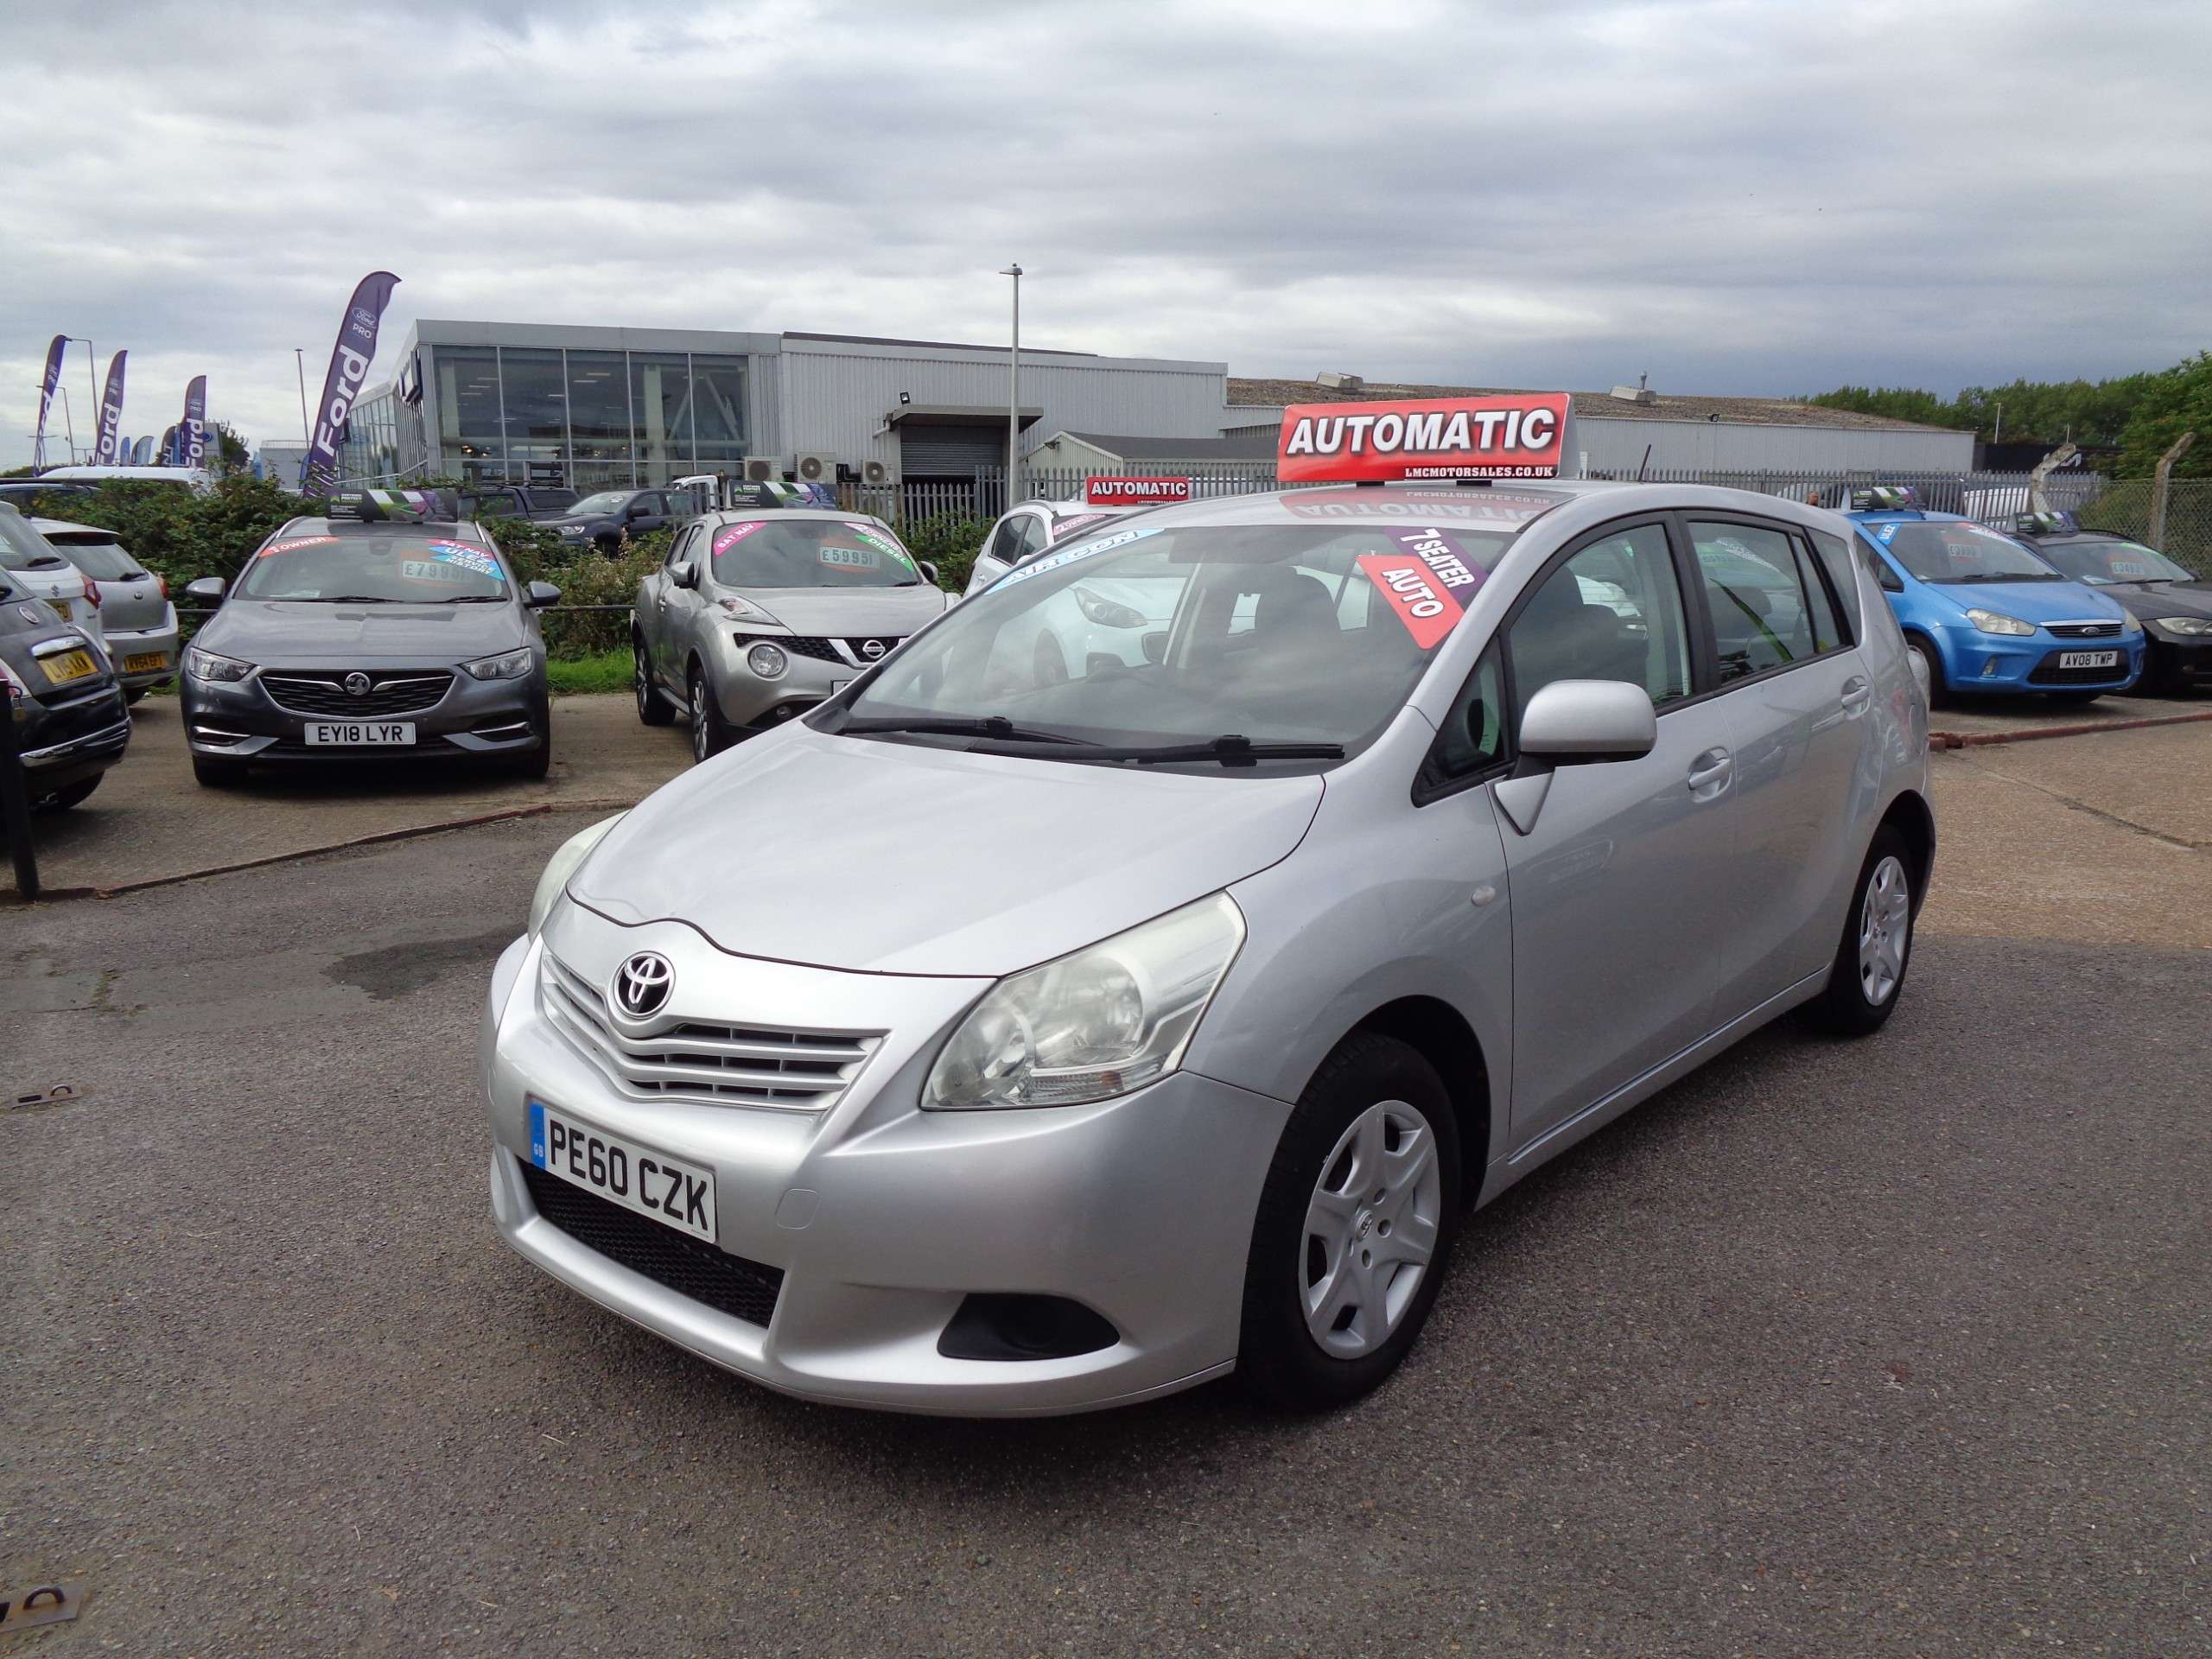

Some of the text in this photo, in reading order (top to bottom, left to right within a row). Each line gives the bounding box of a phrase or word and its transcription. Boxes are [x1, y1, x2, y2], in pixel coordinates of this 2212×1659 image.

[353, 323, 372, 339] PRO
[316, 344, 370, 457] Ford
[1286, 408, 1555, 455] AUTOMATIC
[1405, 466, 1554, 479] LMCMOTORSALES.CO.UK
[1090, 481, 1188, 496] AUTOMATIC
[717, 523, 755, 549] SAT NAV
[1878, 524, 1897, 541] ULEZ
[280, 537, 327, 550] OWNER
[868, 537, 906, 564] DIESEL
[445, 547, 492, 563] ULEZ
[464, 546, 490, 559] NAV
[1005, 530, 1141, 584] AIR CON
[1400, 527, 1476, 588] 7 SEATER
[1382, 568, 1445, 618] AUTO
[2064, 652, 2113, 665] AV08 TWP
[317, 726, 403, 742] EY18 LYR
[533, 1142, 544, 1158] GB
[549, 1118, 709, 1231] PE60 CZK
